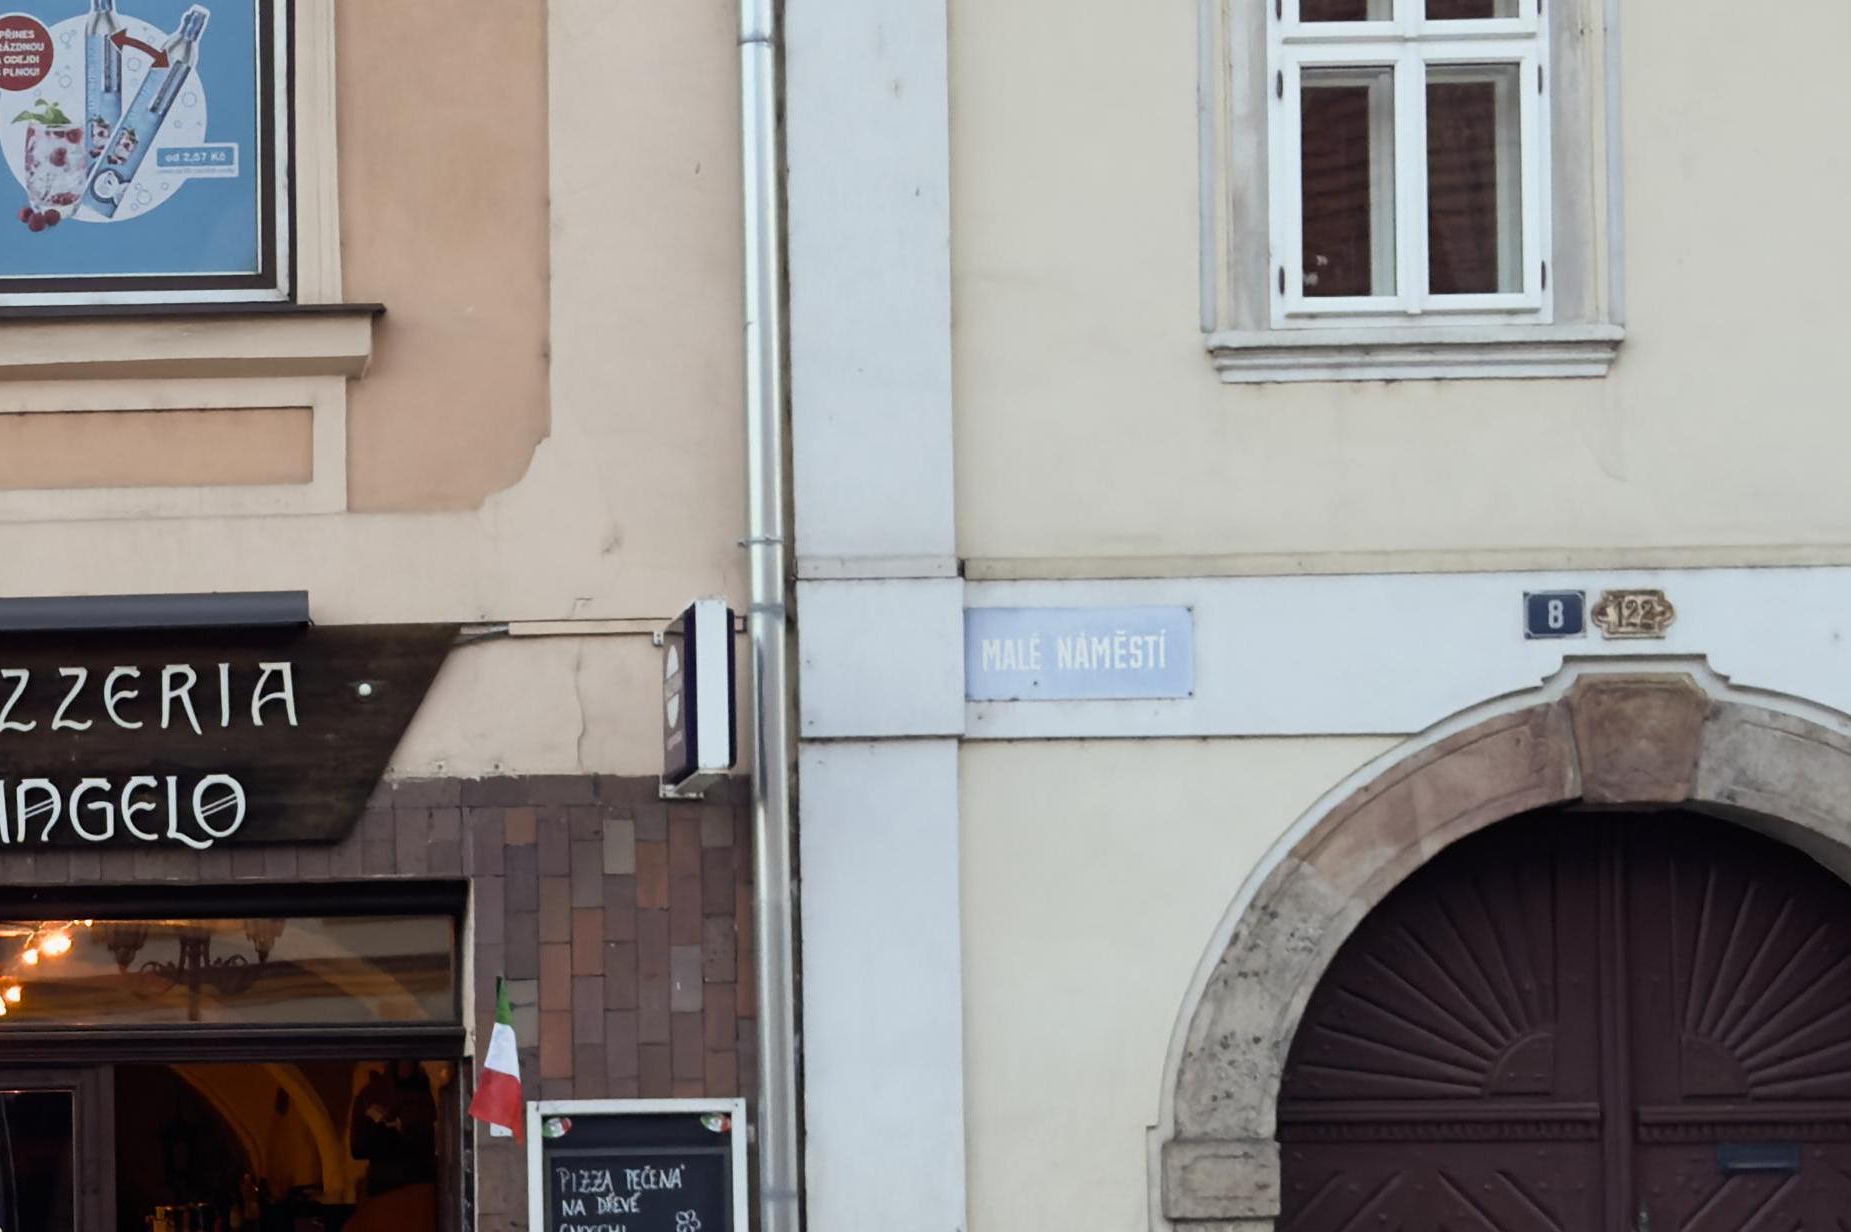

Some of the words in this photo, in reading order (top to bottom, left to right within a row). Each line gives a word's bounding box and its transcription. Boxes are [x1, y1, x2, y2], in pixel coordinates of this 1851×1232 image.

[1548, 599, 1564, 629] 8
[981, 632, 1042, 672] MALÉ
[1056, 629, 1167, 670] NÁMĚSTÍ
[557, 1167, 613, 1193] PIZZA
[562, 1199, 587, 1216] NA
